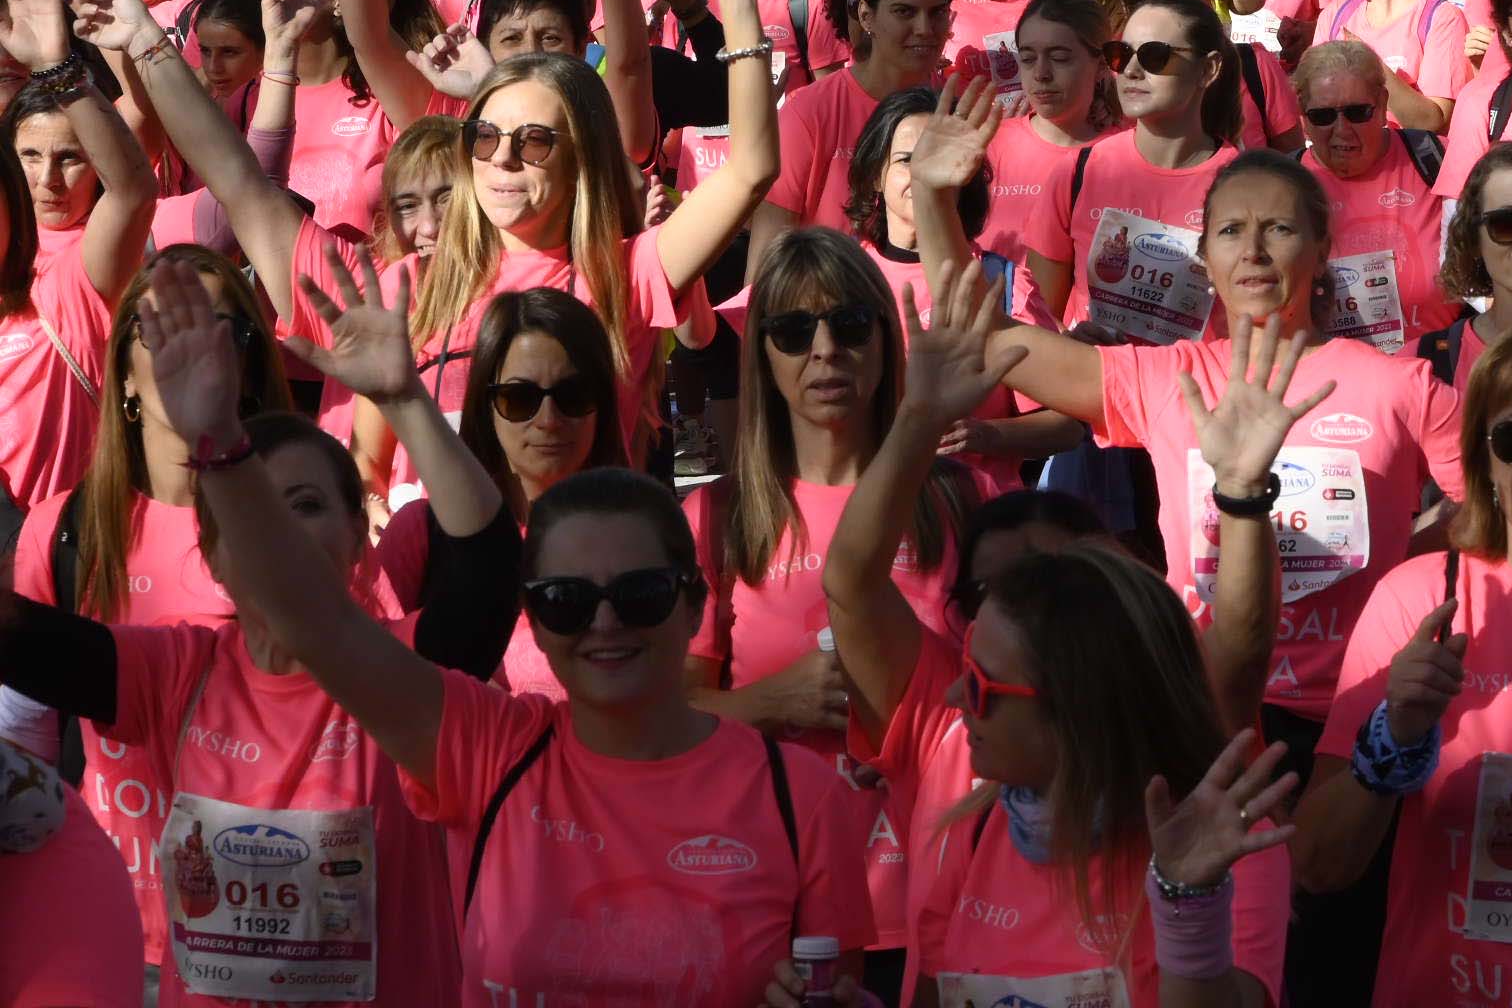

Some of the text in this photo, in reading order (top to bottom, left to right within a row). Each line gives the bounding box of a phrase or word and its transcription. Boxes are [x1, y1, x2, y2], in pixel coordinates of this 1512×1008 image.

[696, 147, 728, 168] SUM
[993, 184, 1042, 196] OYSHO
[1140, 238, 1185, 258] ASTURIANA
[1130, 264, 1174, 288] 016
[1335, 296, 1358, 313] 16
[1322, 468, 1351, 478] SUMA
[1271, 510, 1308, 533] 16
[1278, 539, 1297, 552] 62
[768, 553, 822, 582] YSHO
[1291, 559, 1325, 568] MUJER
[1302, 579, 1337, 591] Santa
[219, 837, 303, 860] ASTURIANA
[319, 837, 361, 849] SUMA
[1444, 828, 1467, 871] T
[675, 847, 751, 868] ASTURIANA
[224, 880, 301, 910] 016
[958, 896, 1022, 929] YSHO
[232, 915, 291, 935] 11992
[238, 940, 257, 952] DE
[257, 941, 275, 954] LA
[275, 943, 320, 956] MUJER
[288, 972, 359, 985] Santander
